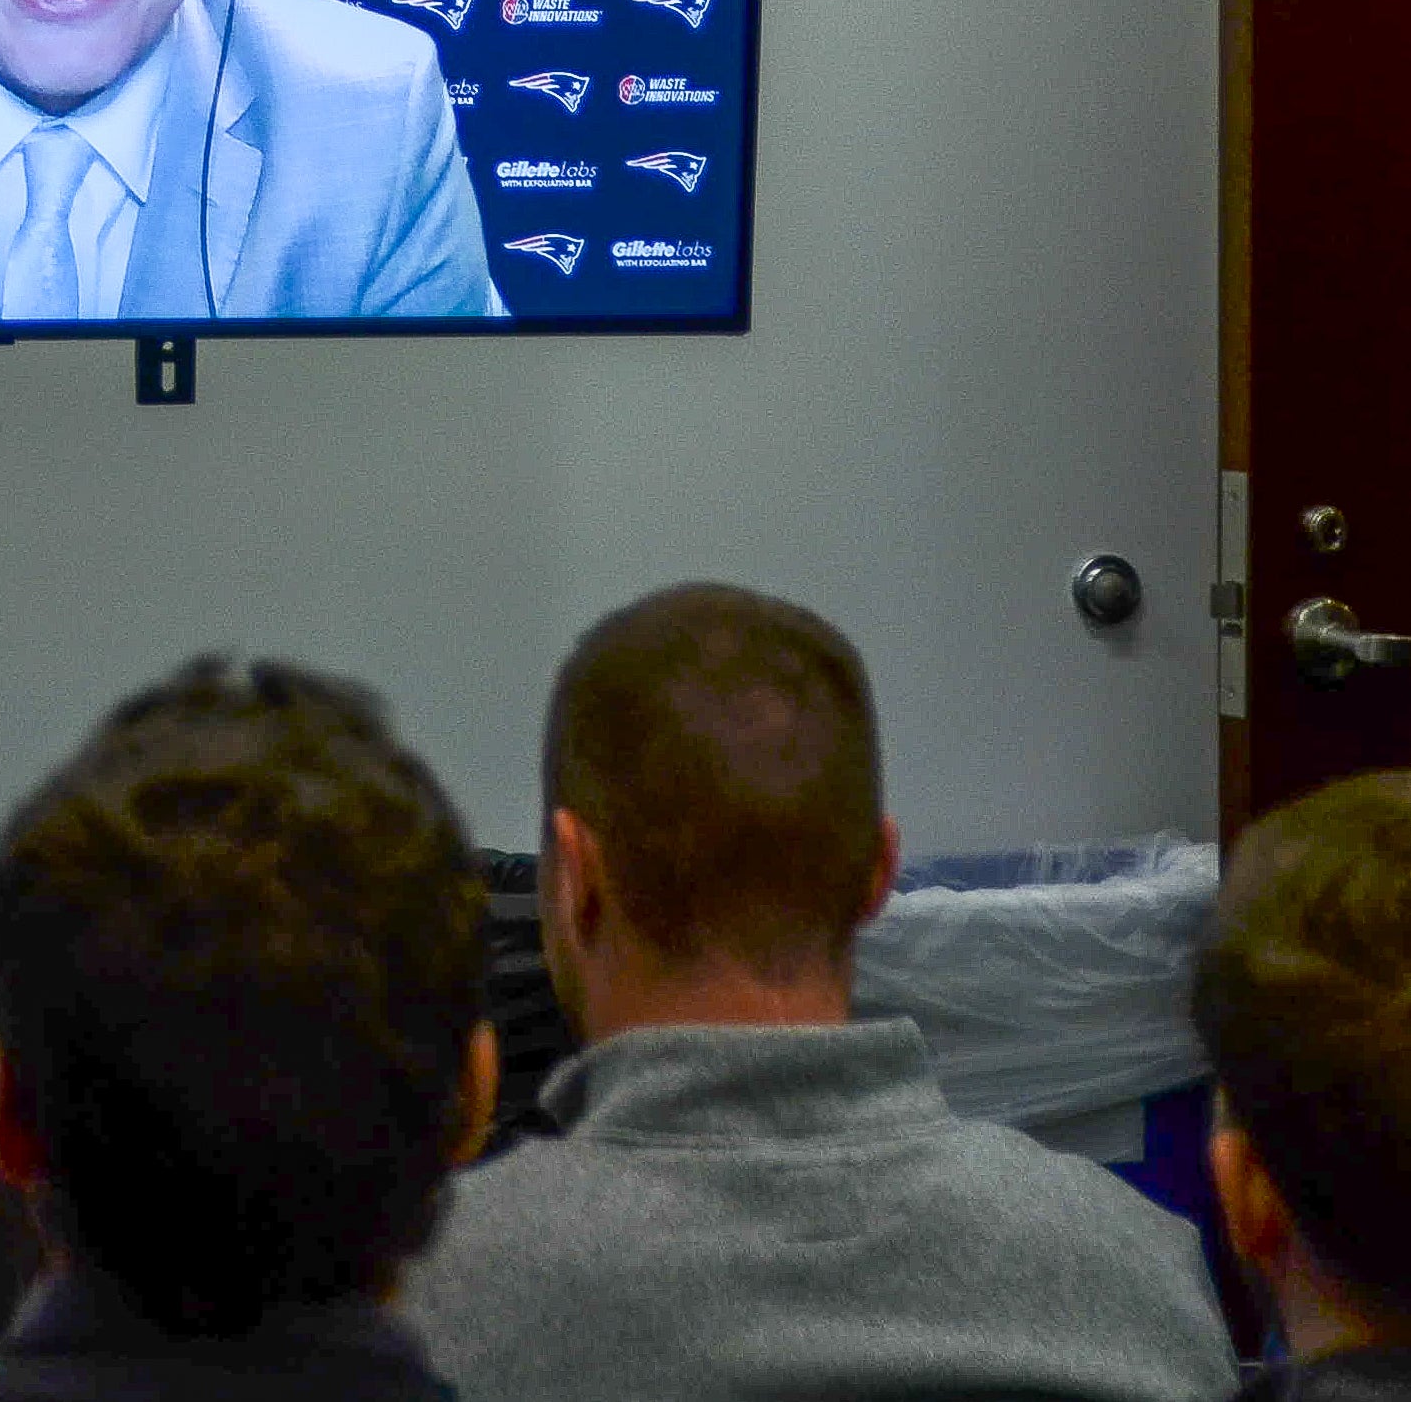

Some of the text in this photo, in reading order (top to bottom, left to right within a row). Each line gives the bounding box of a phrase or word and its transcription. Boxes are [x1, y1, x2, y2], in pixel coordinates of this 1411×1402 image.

[528, 11, 598, 22] INNOVATIONS
[649, 77, 687, 90] WASTE
[645, 91, 715, 102] INNOVATIONS
